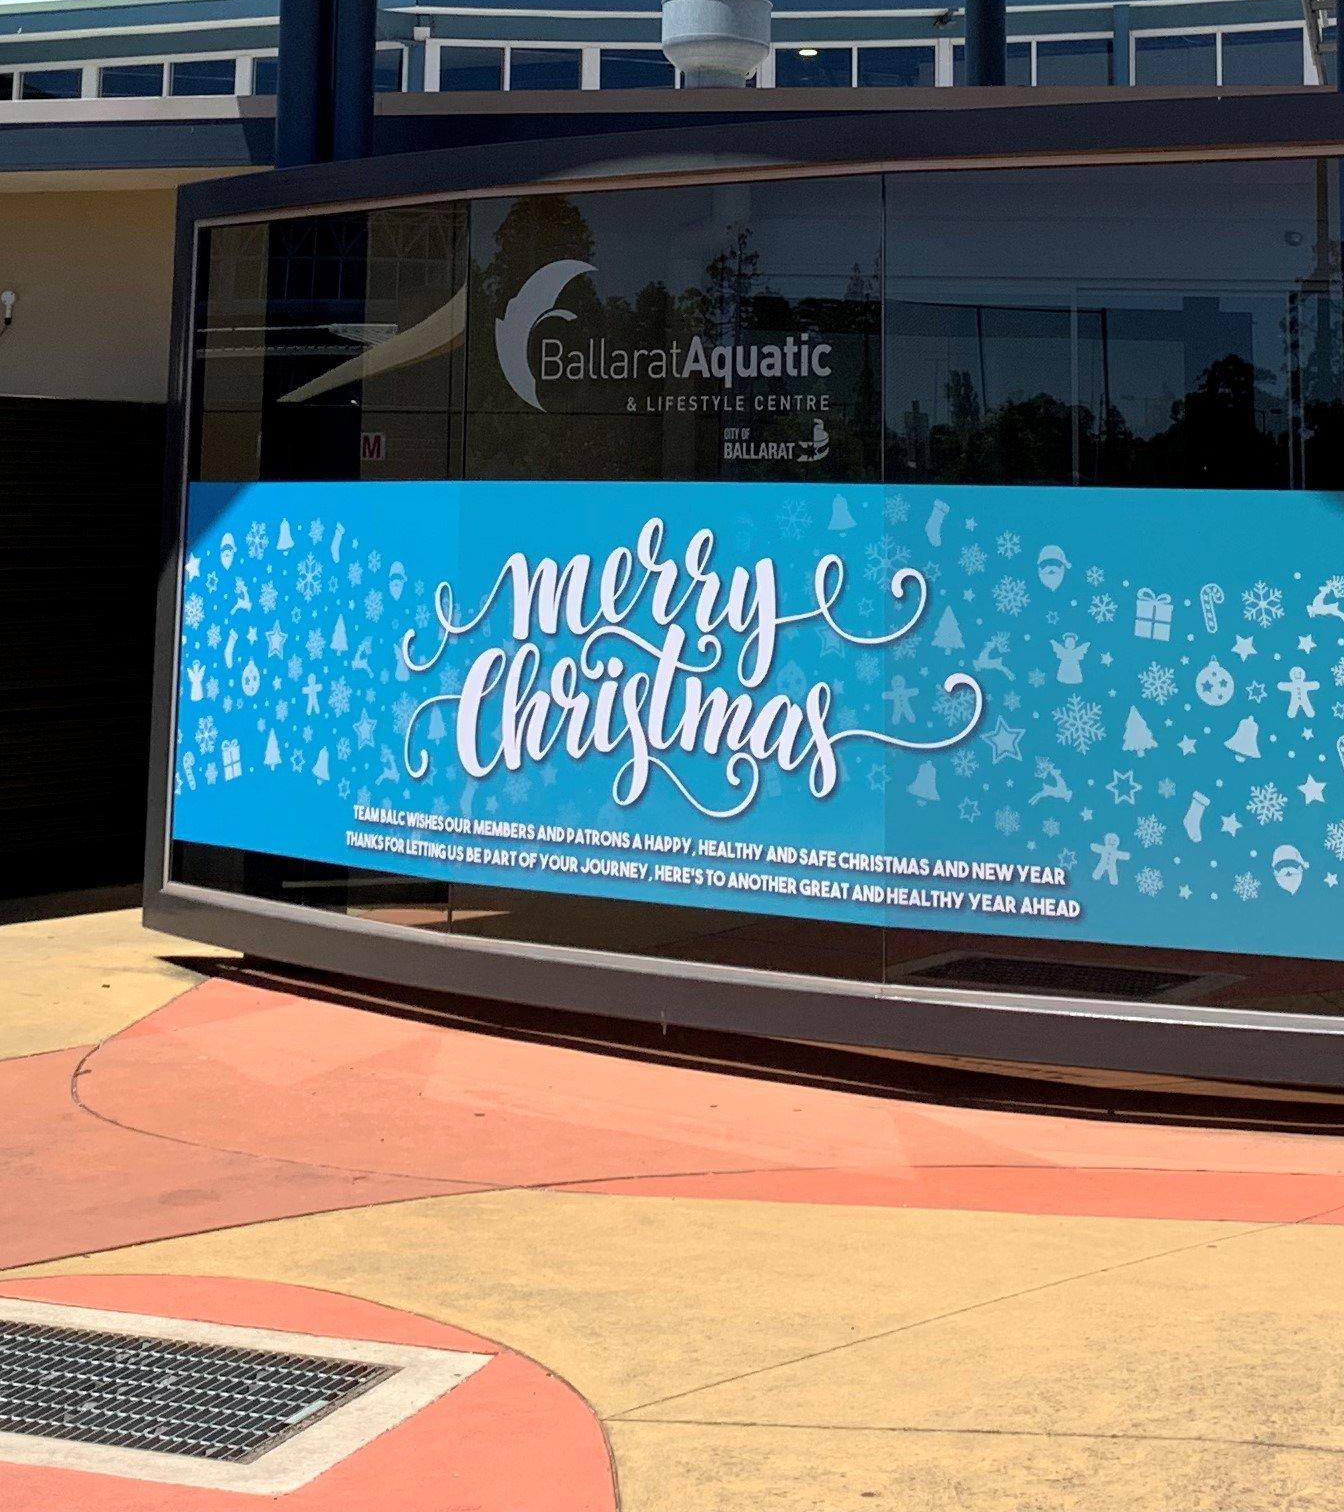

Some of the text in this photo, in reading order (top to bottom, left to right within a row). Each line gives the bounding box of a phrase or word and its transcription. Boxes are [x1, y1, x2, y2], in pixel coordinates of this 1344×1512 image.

[541, 333, 833, 388] BallaratAquatic
[626, 395, 830, 412] & LIFESTYLE CENTRE
[723, 441, 795, 460] BALLARAT
[724, 427, 751, 439] CITY OF
[421, 626, 926, 813] Christmas
[353, 805, 1066, 886] TEAM BALC WISHES OUR MEMBERS AND PATRONS A HAPPY, HEALTHY AND SAFE CHRISTMAS AND NEW YEAR
[346, 831, 1081, 918] THANKS FOR LETTING US BE PART OF YOUR JOURNEY, HERE'S TO ANOTHER GREAT AND HEALTHY YEAR AHEAD
